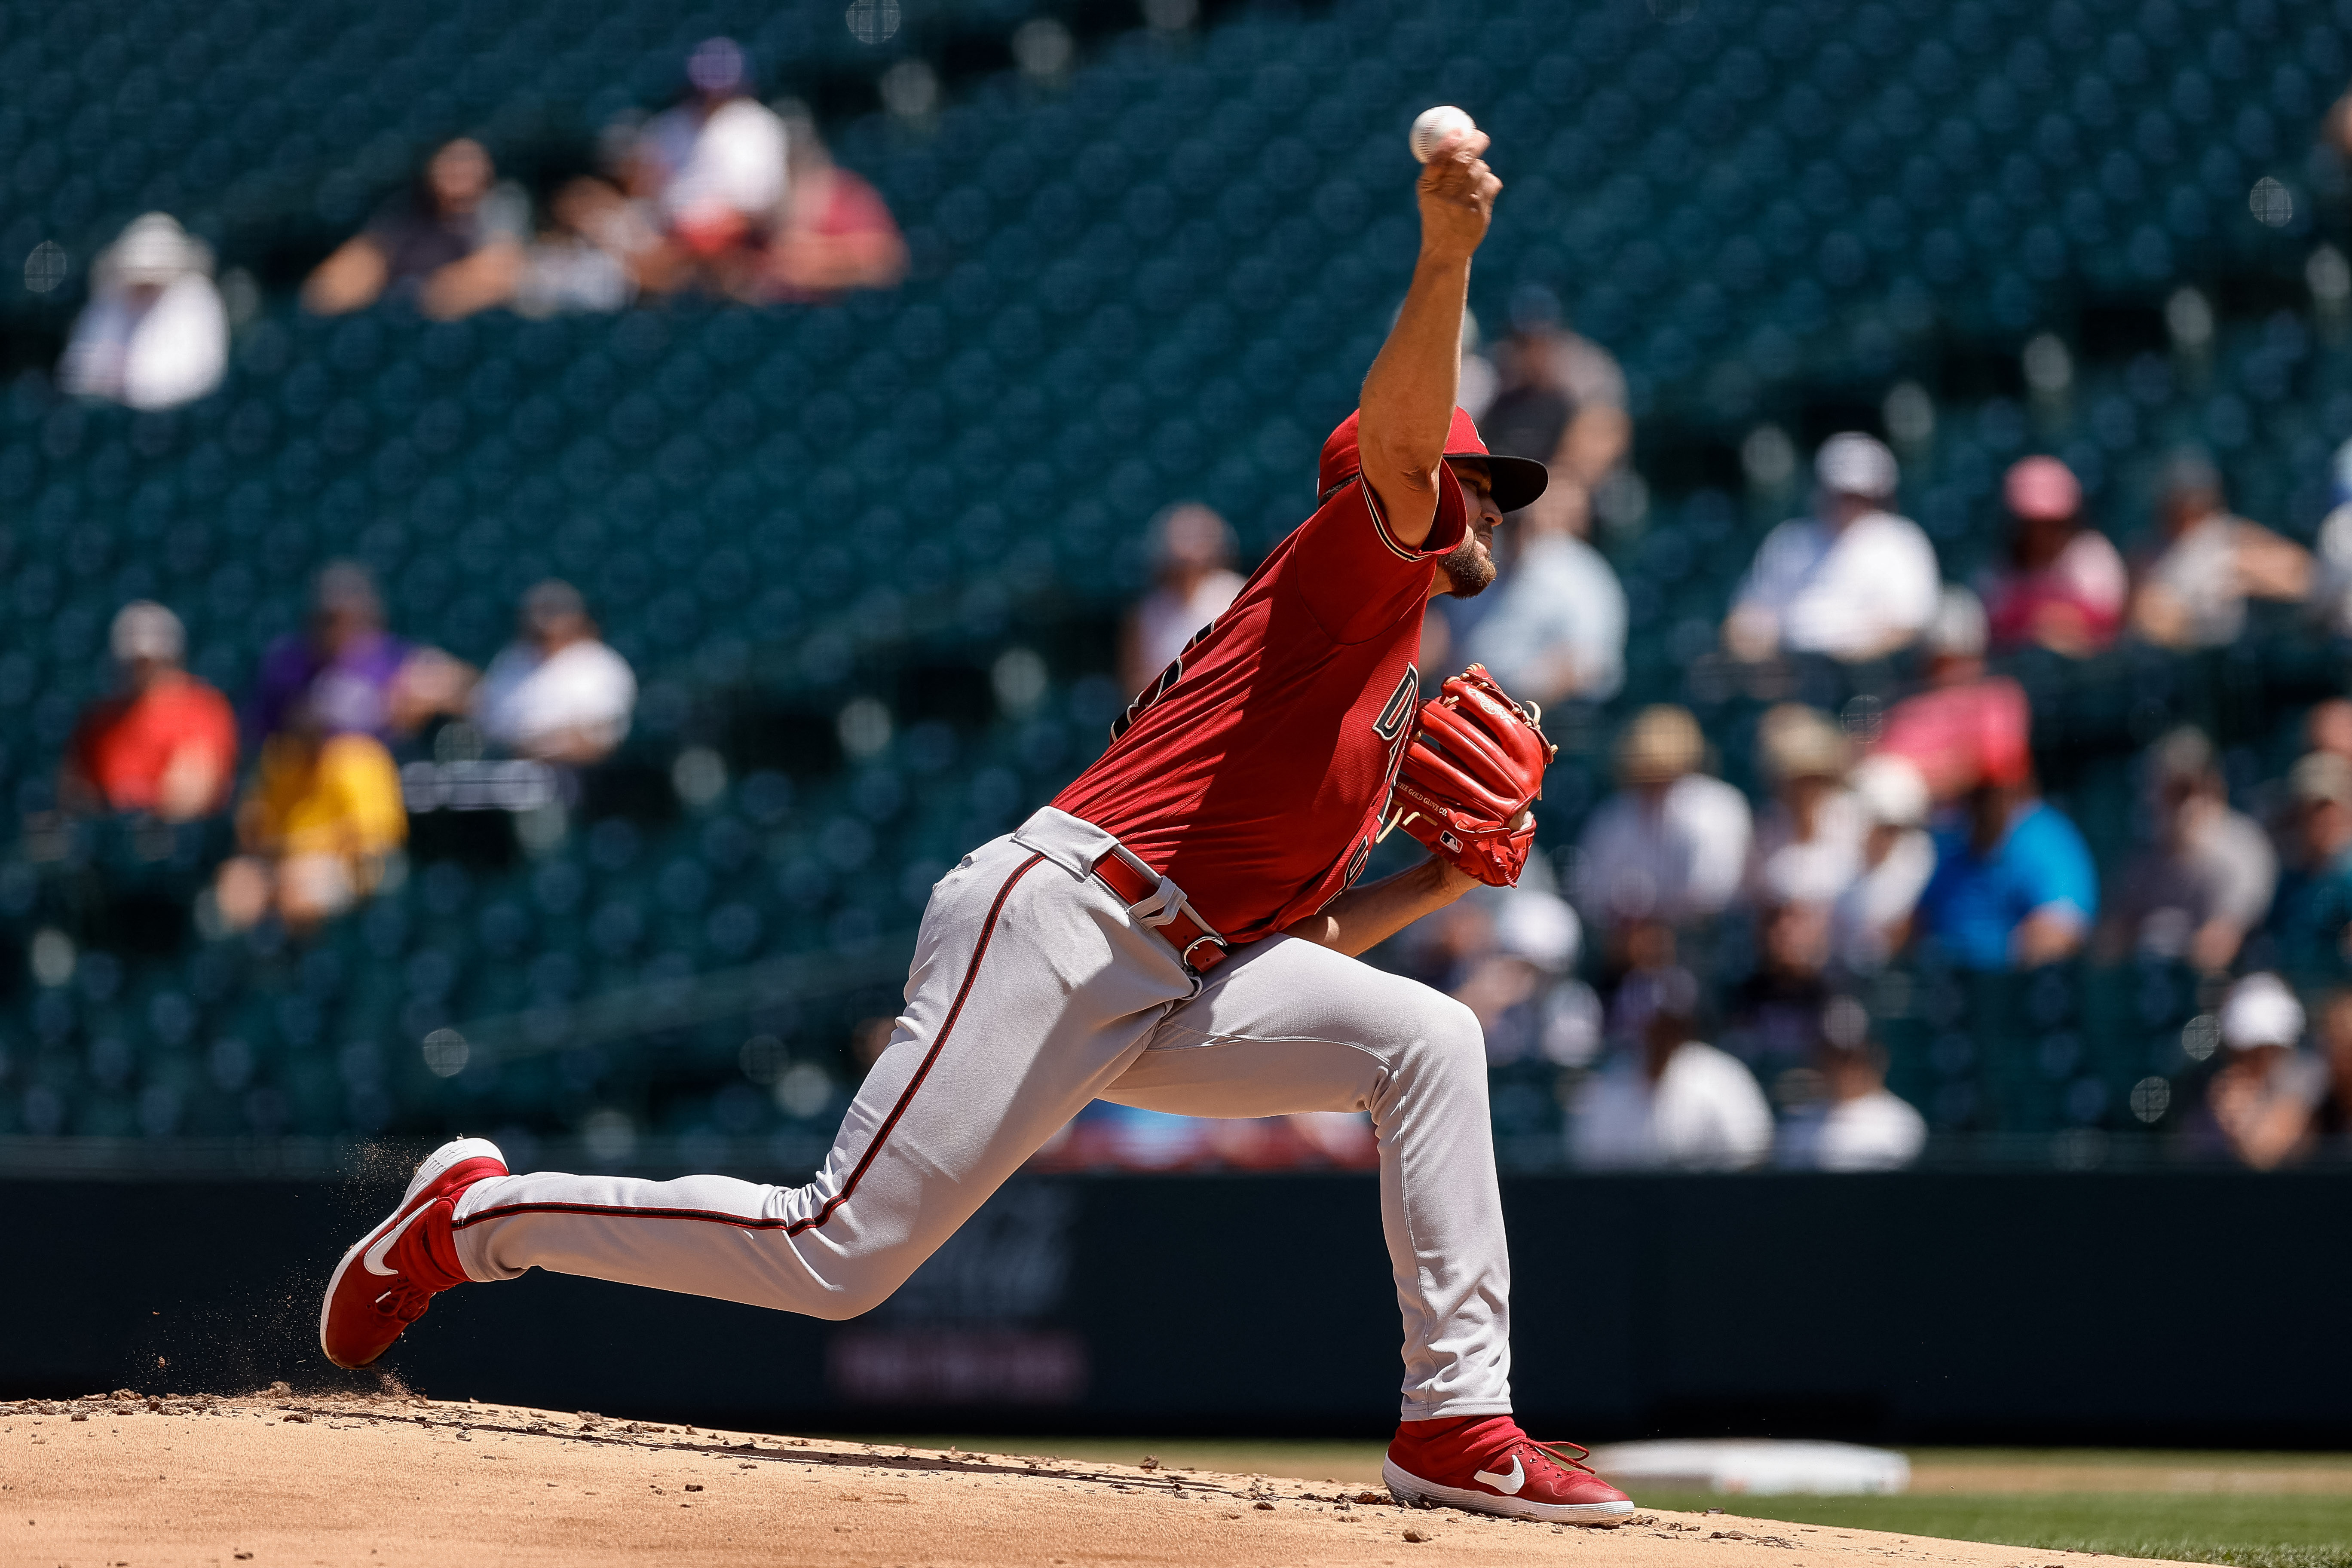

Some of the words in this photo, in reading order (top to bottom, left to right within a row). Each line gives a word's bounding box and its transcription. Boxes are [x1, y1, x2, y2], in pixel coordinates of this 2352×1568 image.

[1396, 781, 1409, 792] THE
[1408, 788, 1423, 800] GOLD
[1439, 807, 1447, 817] CO.
